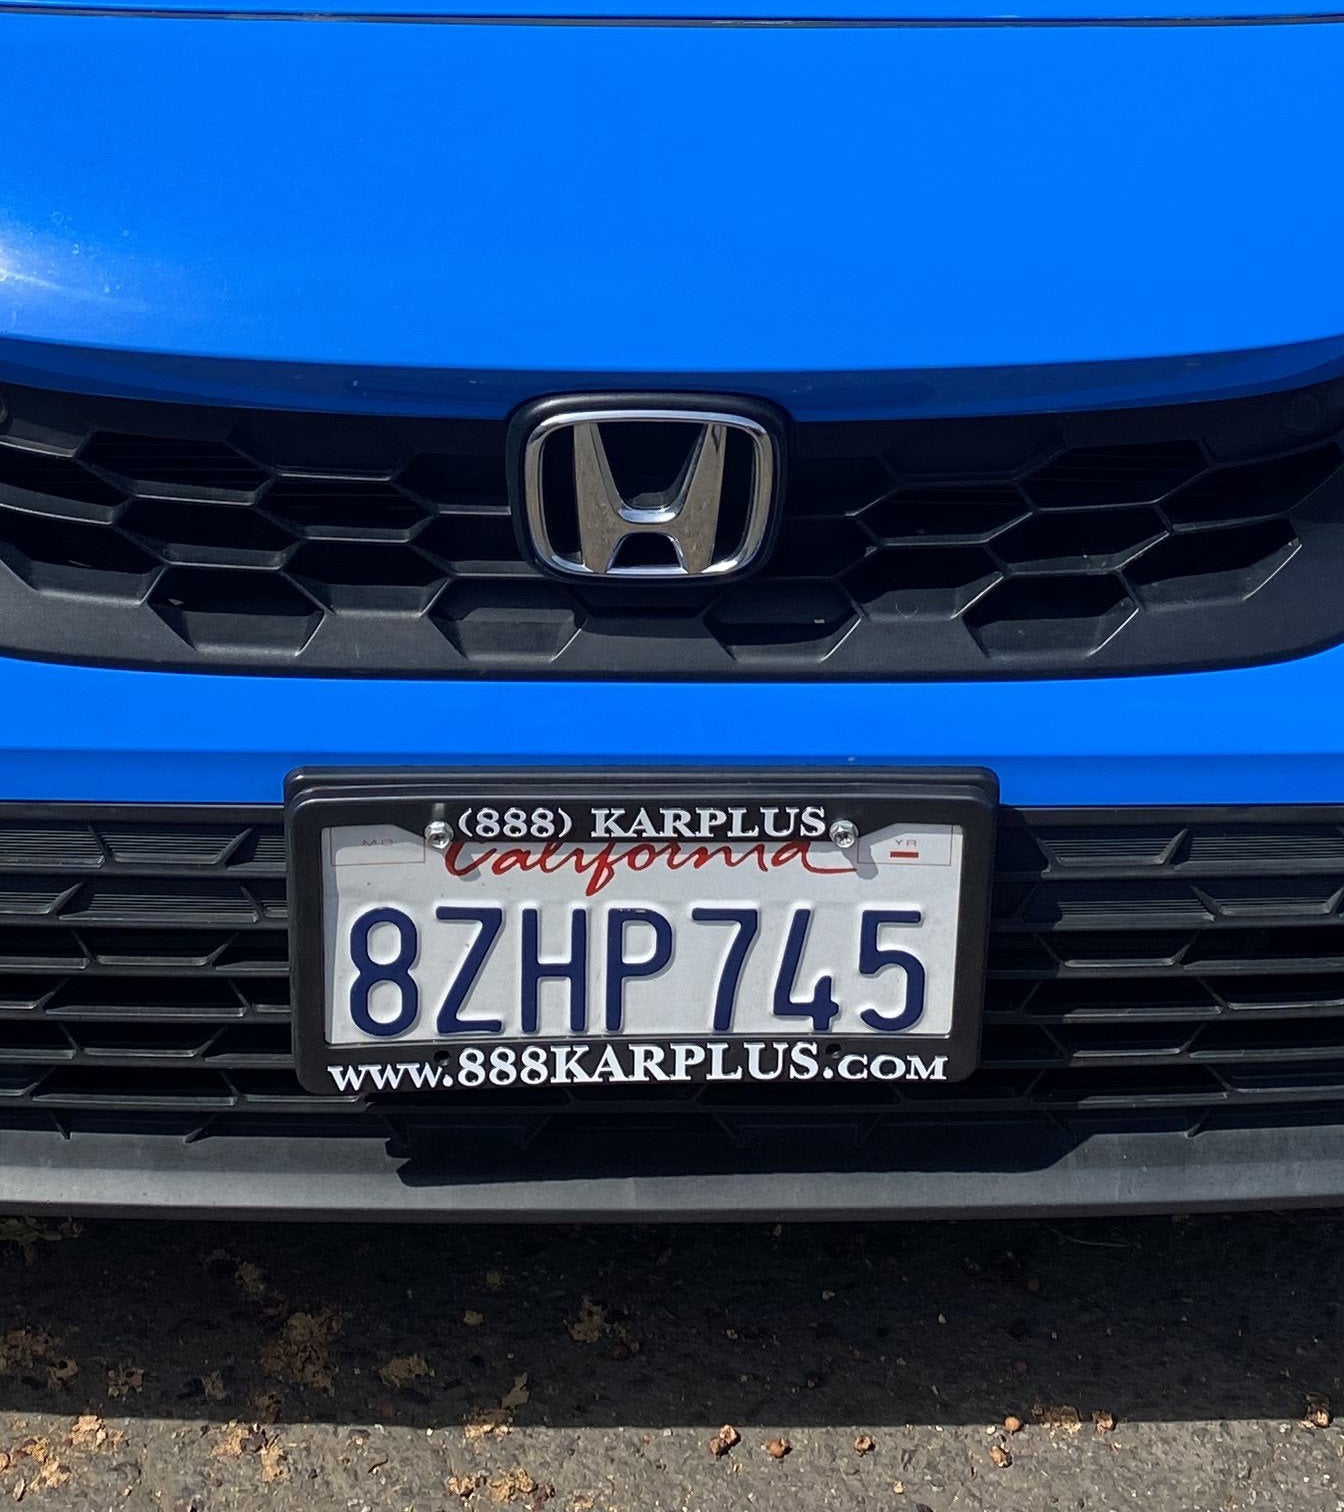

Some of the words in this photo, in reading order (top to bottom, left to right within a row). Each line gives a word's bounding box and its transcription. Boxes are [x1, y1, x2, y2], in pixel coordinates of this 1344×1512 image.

[458, 807, 572, 838] (888)
[590, 806, 827, 838] KARPLUS
[444, 840, 858, 897] California
[349, 906, 927, 1035] 8ZHP745
